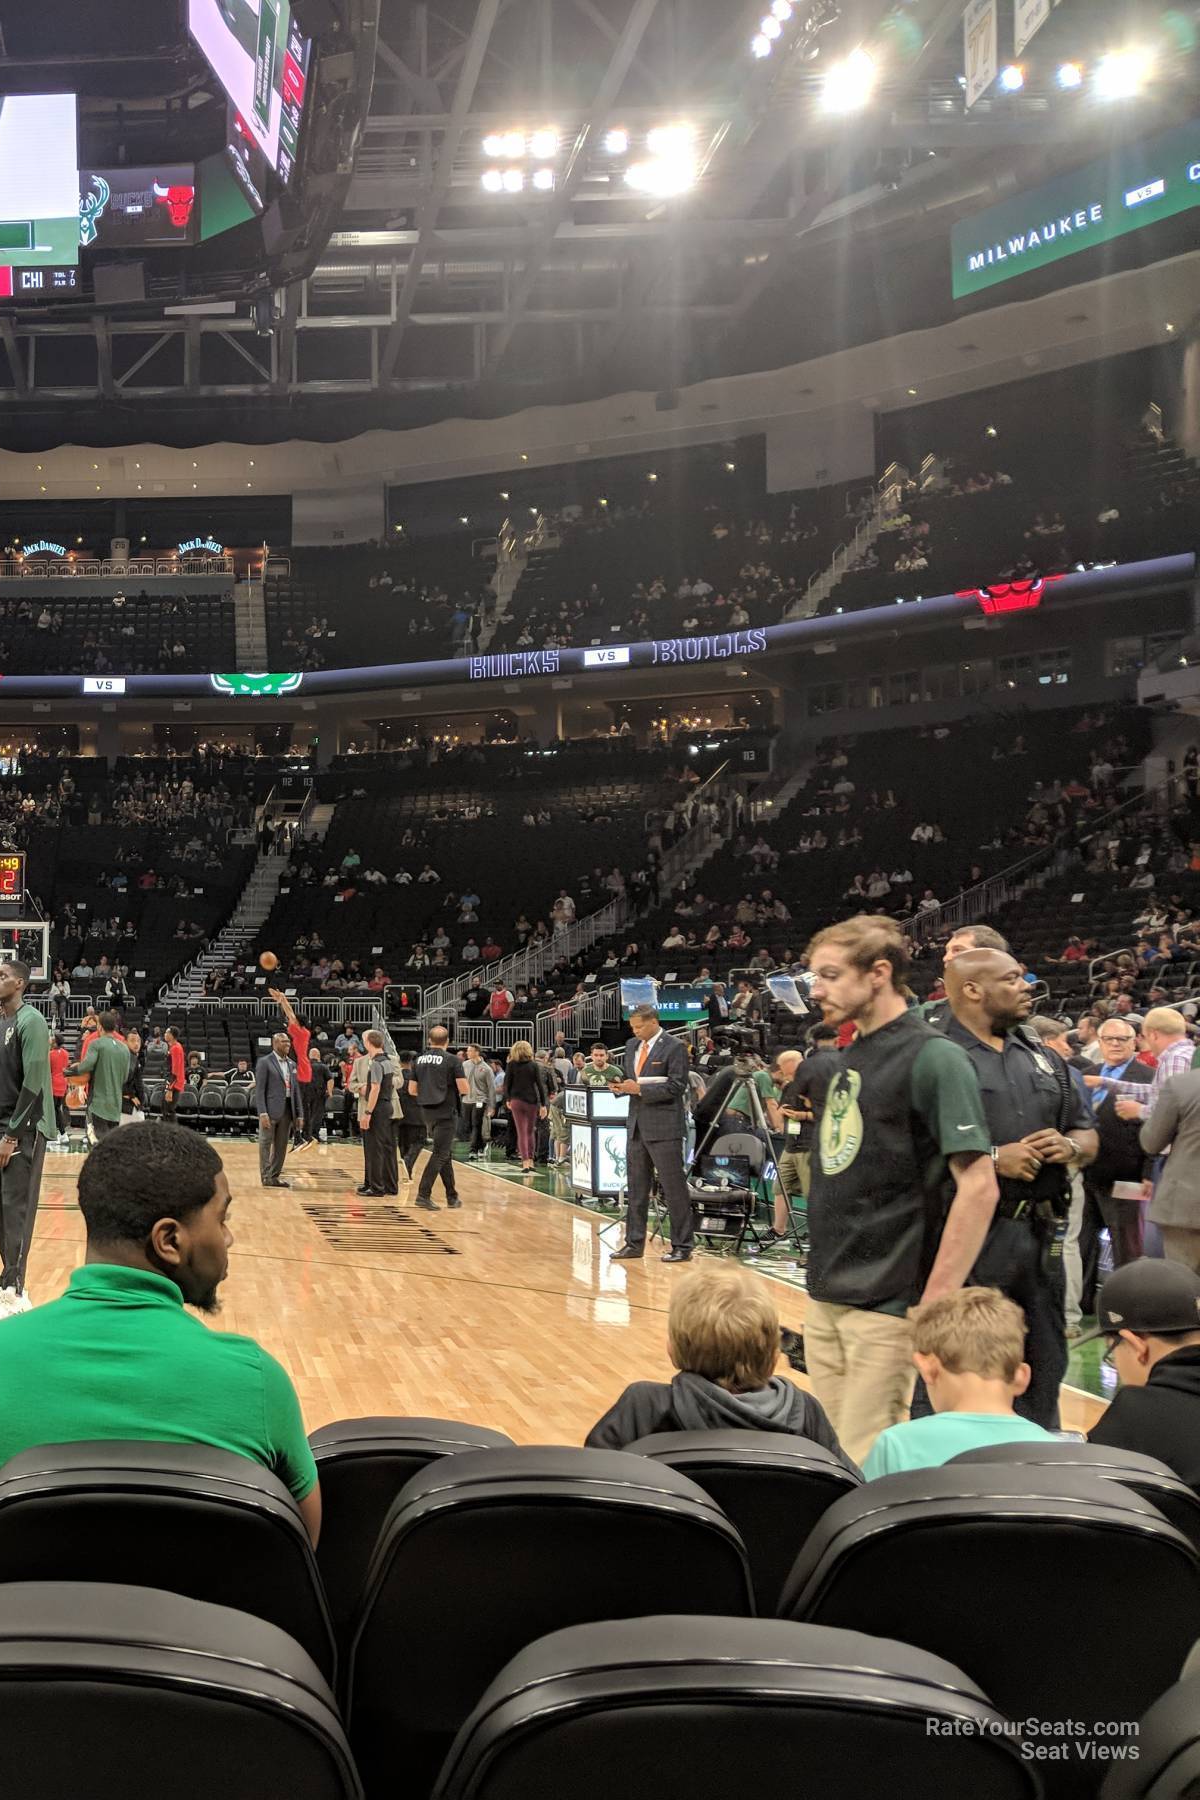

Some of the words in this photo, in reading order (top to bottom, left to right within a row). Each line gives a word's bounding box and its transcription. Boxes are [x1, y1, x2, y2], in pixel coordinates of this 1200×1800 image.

[288, 68, 299, 88] 0
[282, 125, 294, 144] 0
[969, 204, 1103, 270] MILWAUKEE
[22, 271, 43, 289] CHI
[69, 270, 75, 278] 7
[70, 278, 76, 286] 0
[22, 543, 40, 557] JACK
[178, 541, 195, 554] JACK
[469, 649, 560, 680] BUCKS
[597, 651, 616, 662] VS
[652, 627, 768, 664] BULLS
[96, 681, 113, 690] VS
[417, 1054, 443, 1065] PHOTO
